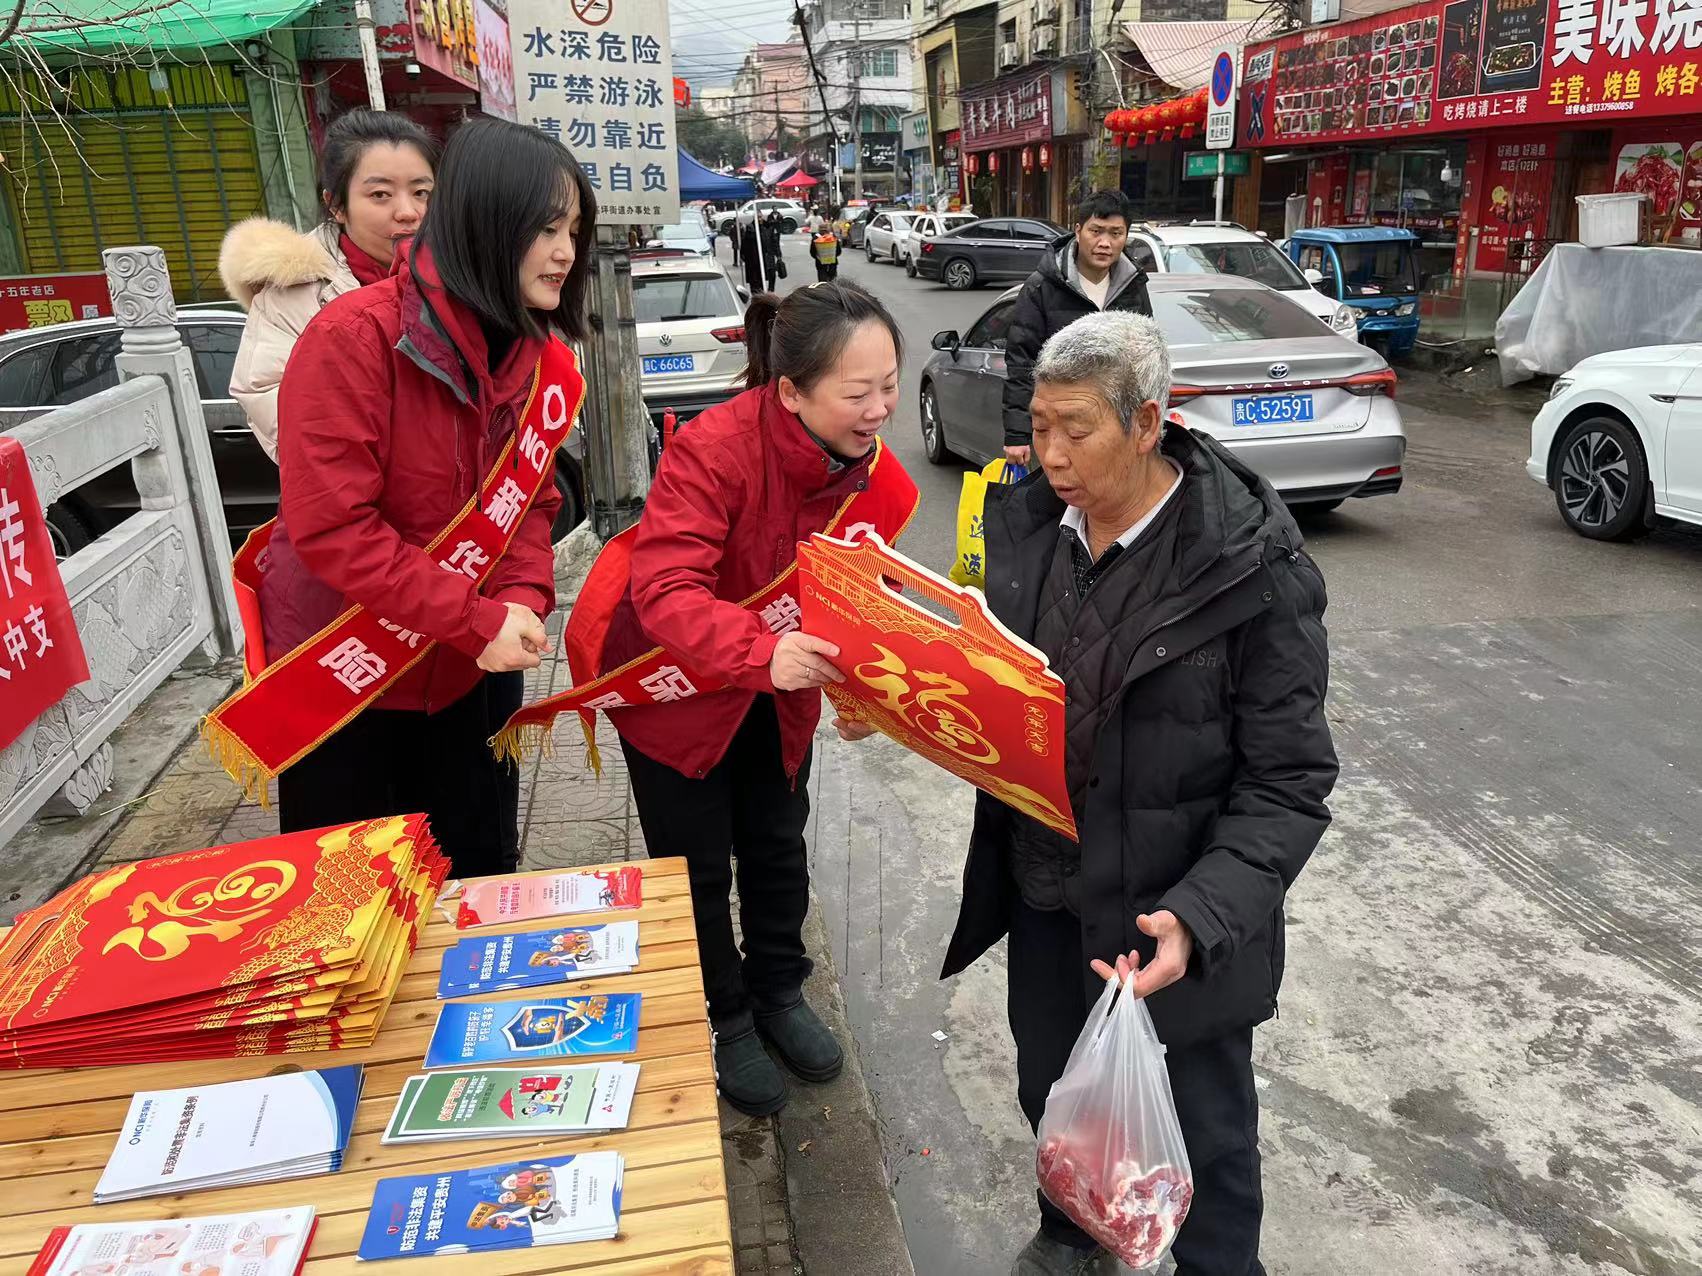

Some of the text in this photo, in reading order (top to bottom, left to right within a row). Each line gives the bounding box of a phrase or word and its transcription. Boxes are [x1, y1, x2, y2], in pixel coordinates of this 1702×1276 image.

[523, 26, 662, 65] 水深危险
[527, 72, 664, 108] 严禁游泳
[1602, 69, 1641, 101] 烤鱼
[1654, 61, 1702, 97] 烤各
[1443, 96, 1528, 121] 吃烤烧请上二楼
[580, 162, 668, 193] 果自负
[1225, 379, 1330, 390] AVALON
[519, 424, 550, 474] NCI
[0, 603, 54, 681] 中支
[480, 941, 498, 980] 防范非法集资
[498, 935, 515, 974] 共建平安贵州
[134, 1124, 145, 1138] NCI
[161, 1095, 199, 1176] 防范和处置非法集资条例
[400, 1186, 429, 1252] 防范非法集资
[424, 1175, 452, 1242] 共建平安贵州
